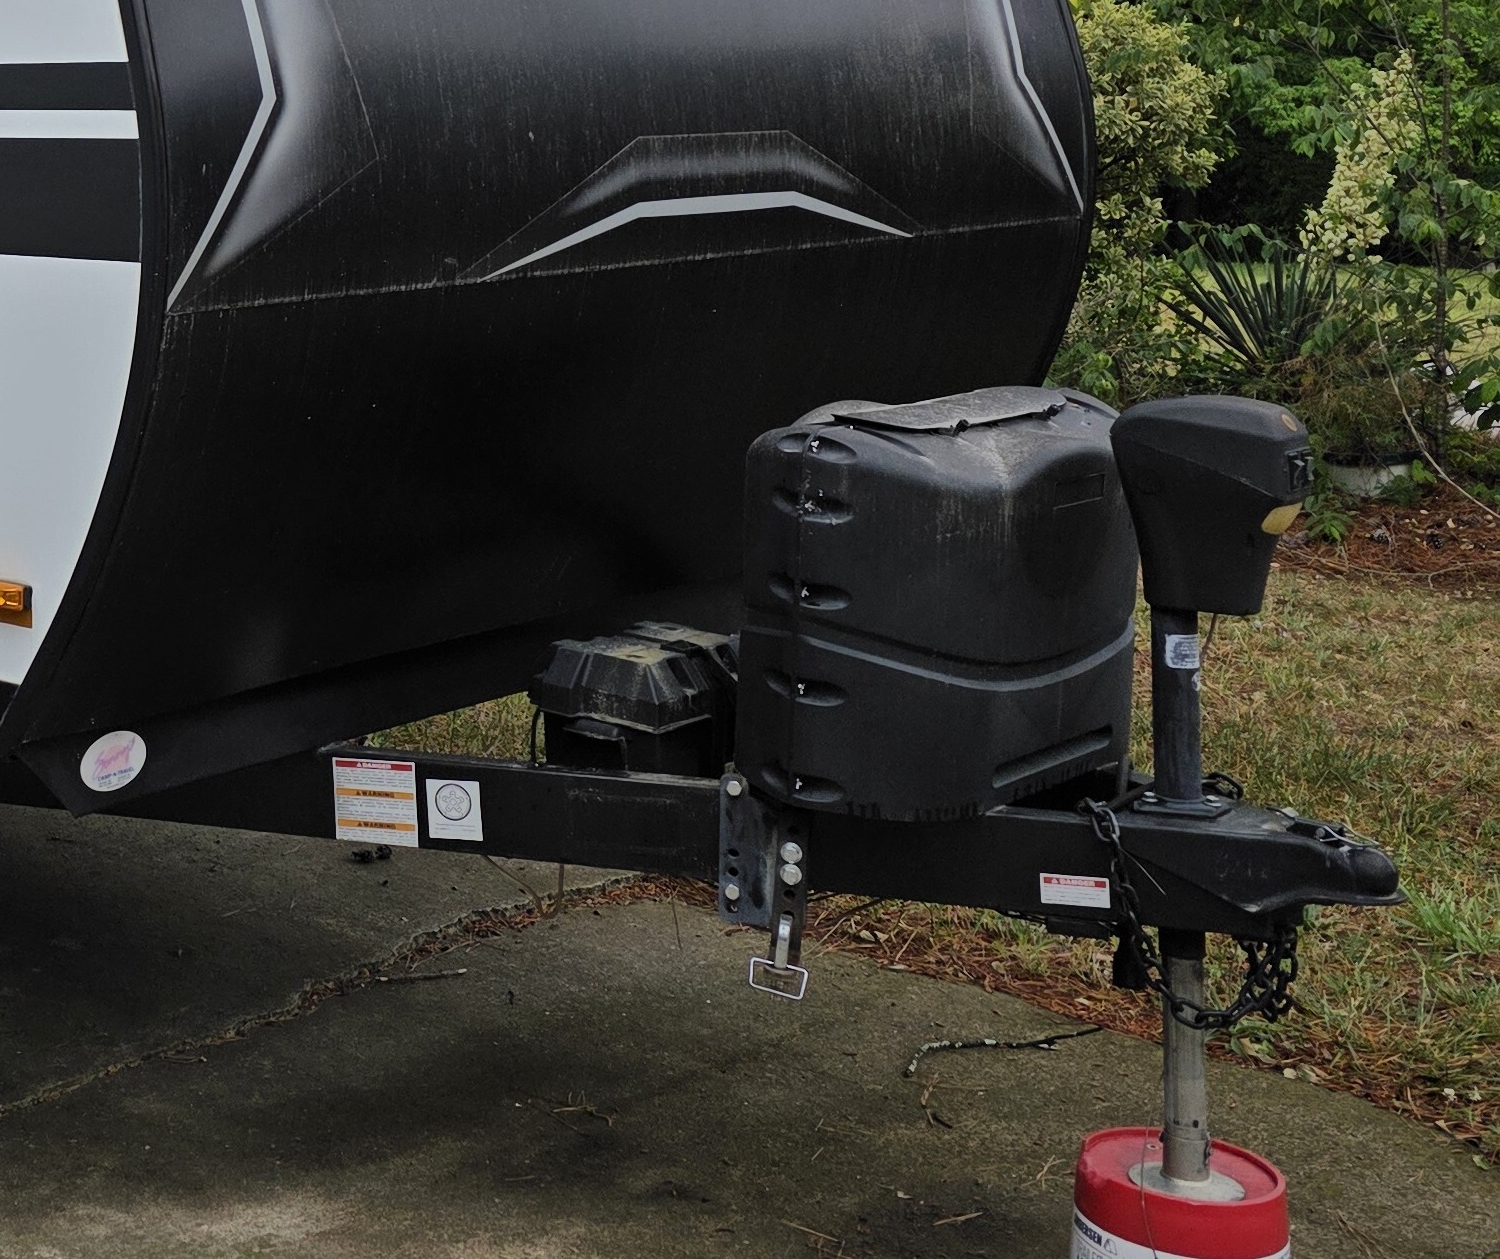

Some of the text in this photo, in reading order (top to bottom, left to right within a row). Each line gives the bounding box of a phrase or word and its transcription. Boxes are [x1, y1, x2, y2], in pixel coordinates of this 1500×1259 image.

[362, 790, 395, 799] WARNING
[362, 821, 396, 830] WARNING
[1059, 878, 1096, 887] DANGER
